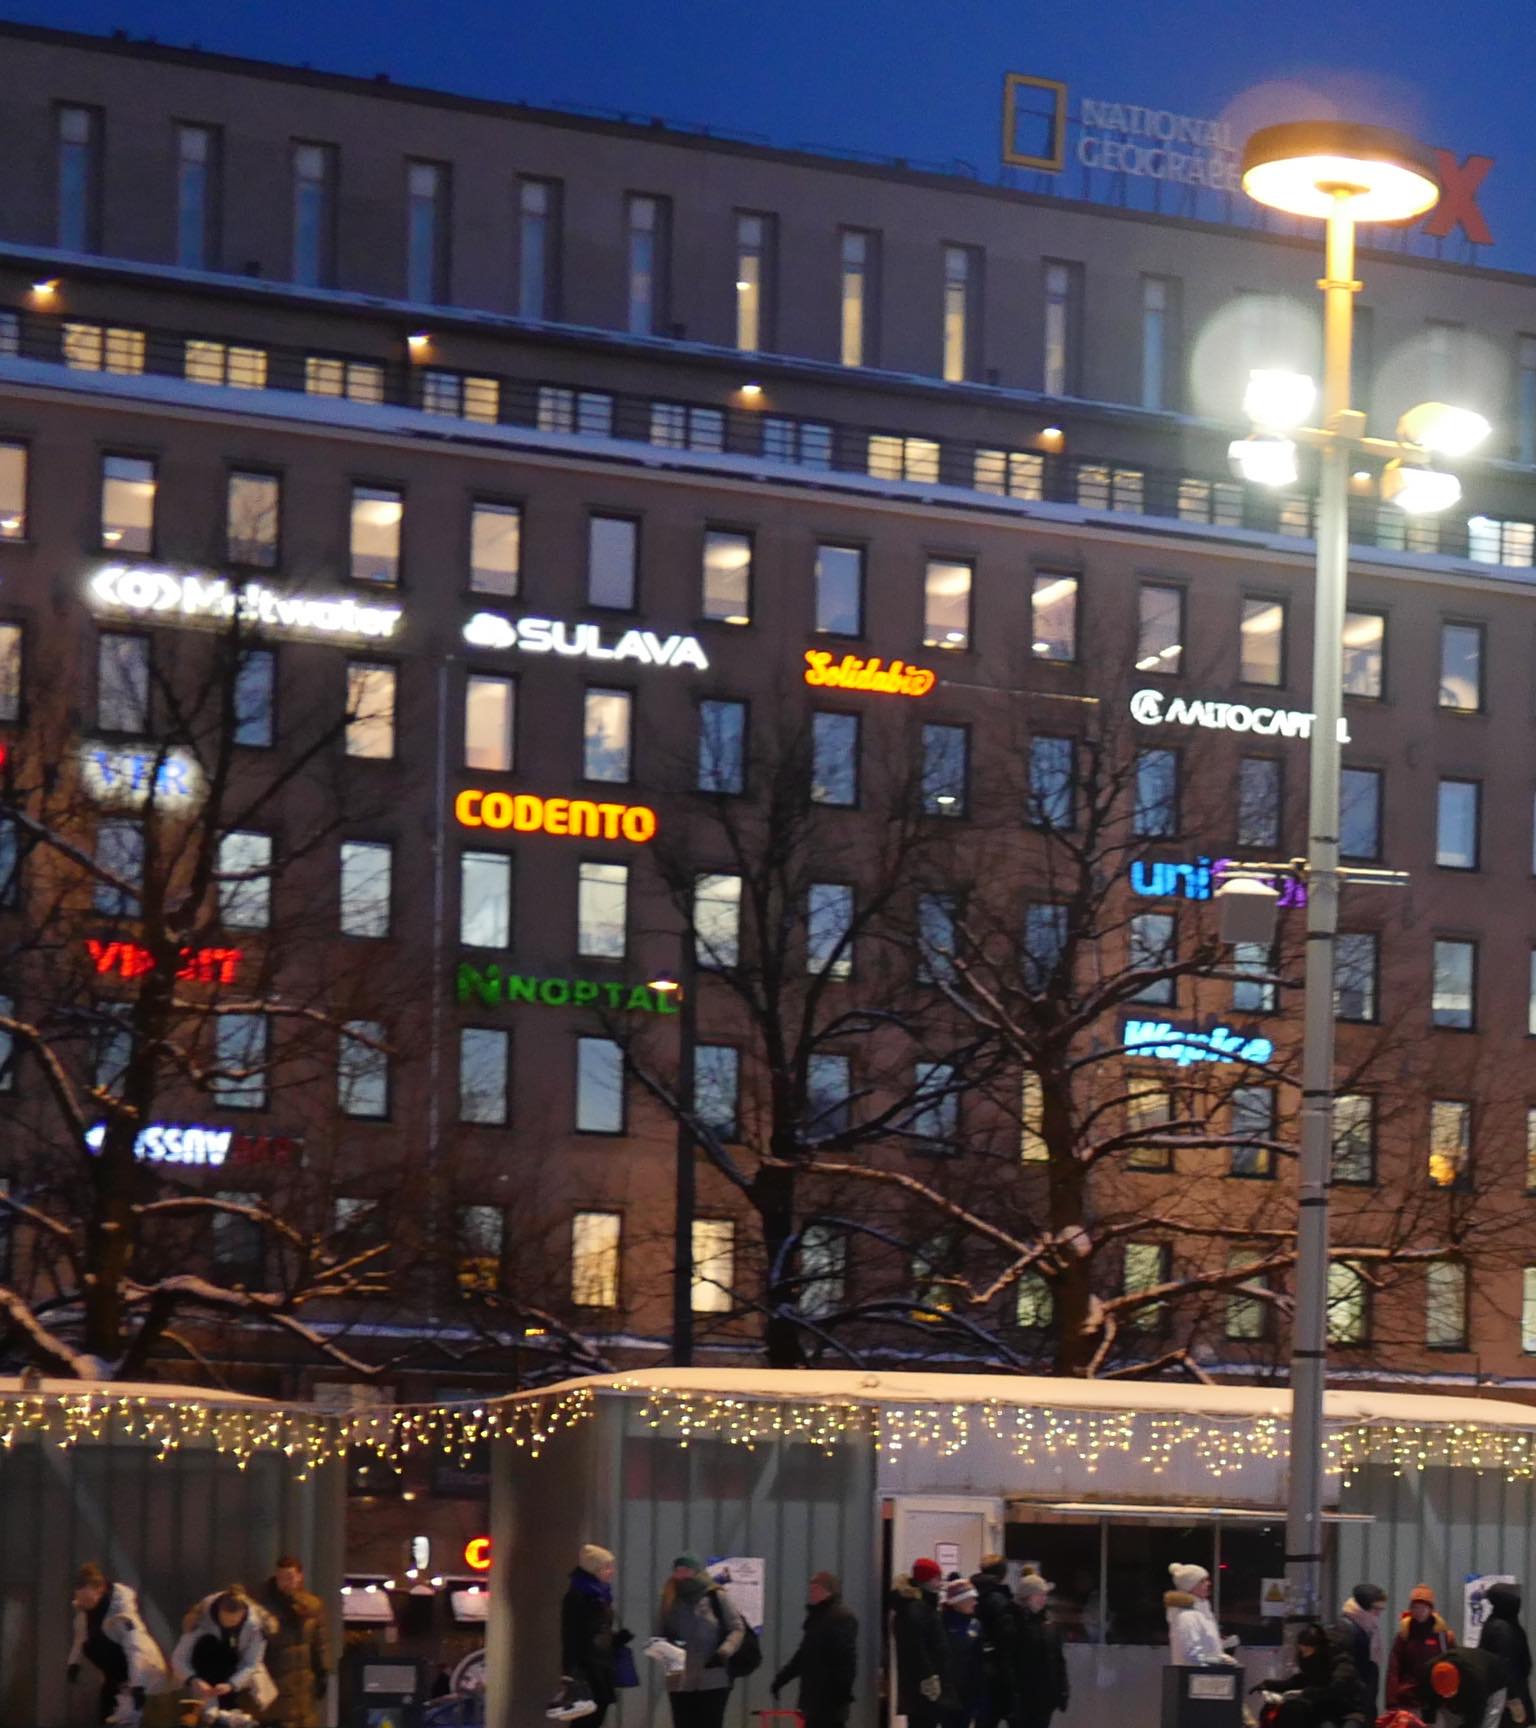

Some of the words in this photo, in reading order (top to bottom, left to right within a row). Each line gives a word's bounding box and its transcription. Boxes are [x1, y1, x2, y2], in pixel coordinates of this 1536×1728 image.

[1081, 99, 1236, 150] NATIONAL
[1079, 137, 1243, 192] GEOGRAP
[517, 617, 708, 669] SULAVA
[1165, 698, 1352, 743] AALTOCAPITL
[455, 789, 656, 842] CODENTO
